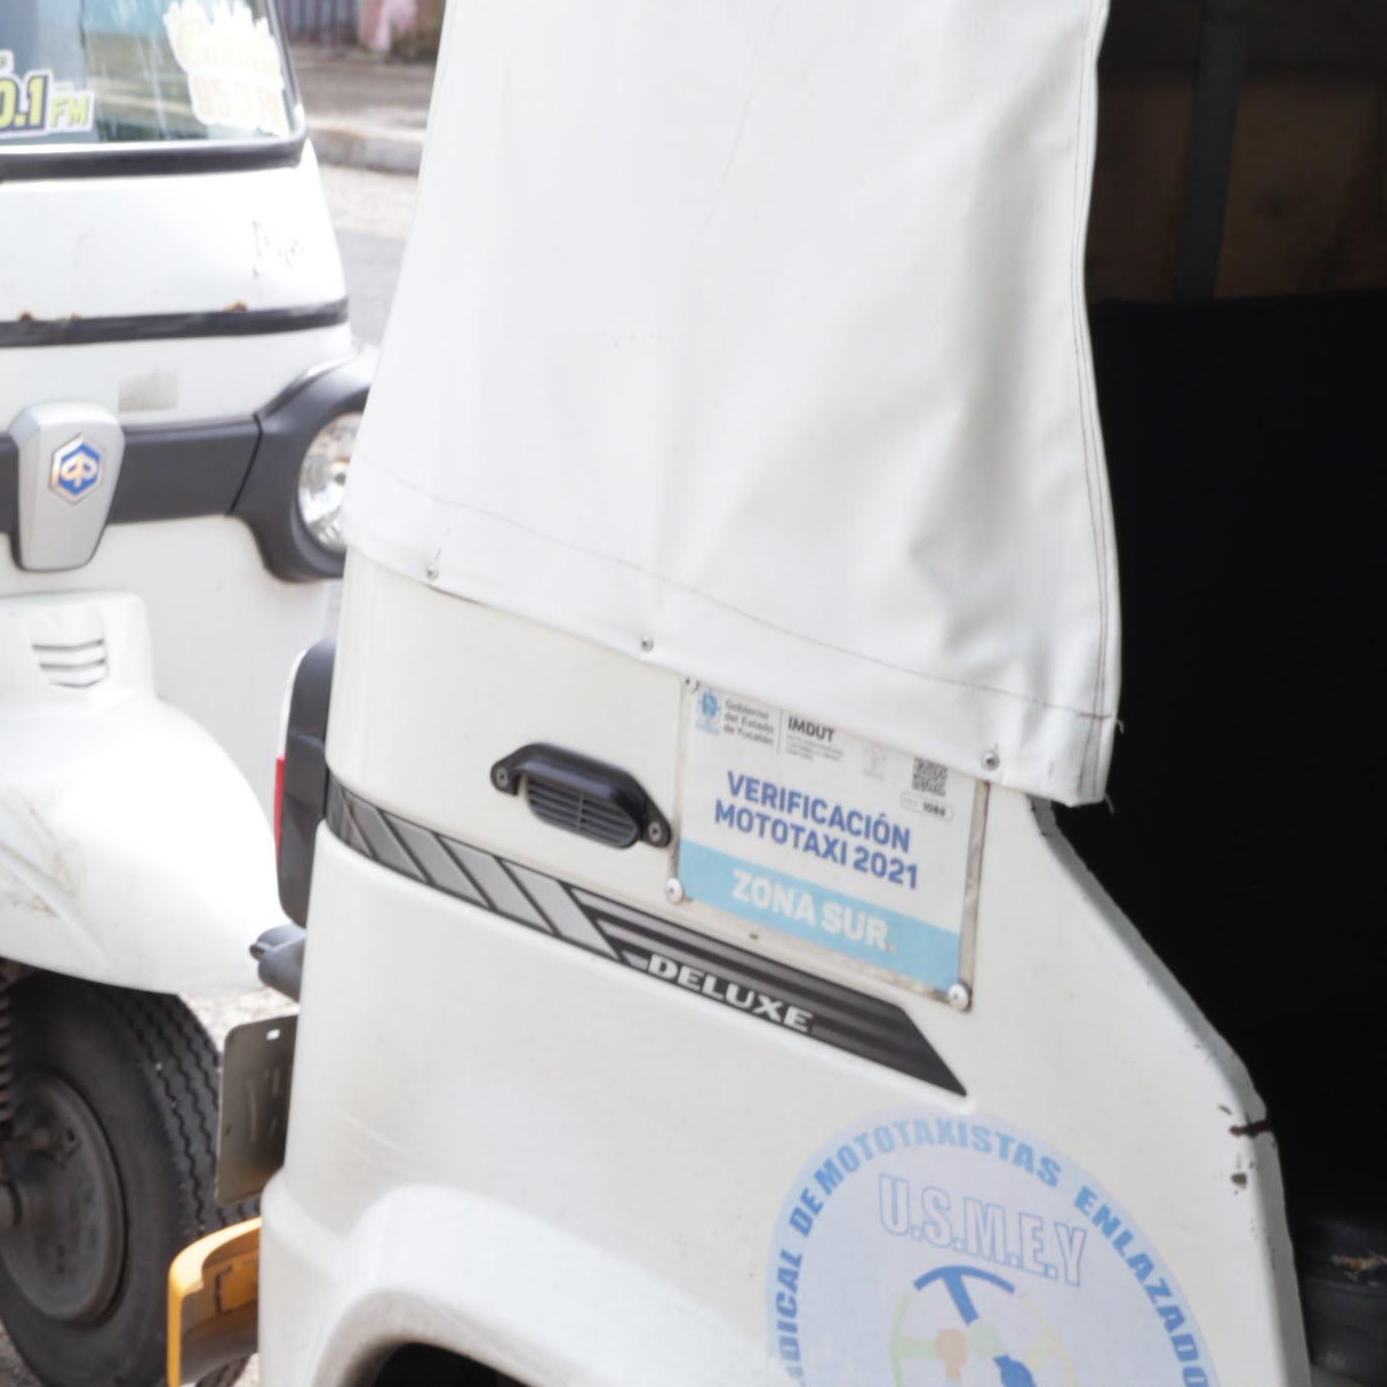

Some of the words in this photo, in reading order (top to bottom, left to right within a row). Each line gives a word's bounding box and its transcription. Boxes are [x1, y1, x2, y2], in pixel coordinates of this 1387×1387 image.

[51, 95, 90, 128] FM
[788, 716, 835, 742] IMDUT
[714, 800, 847, 868] MOTOTAXI
[853, 844, 918, 890] 2021
[727, 770, 910, 853] VERIFICACIÓN
[732, 869, 814, 926] ZONA
[647, 953, 813, 1033] DELUXE
[788, 1187, 825, 1238] DE
[814, 1117, 1061, 1197] MOTOTAXISTAS
